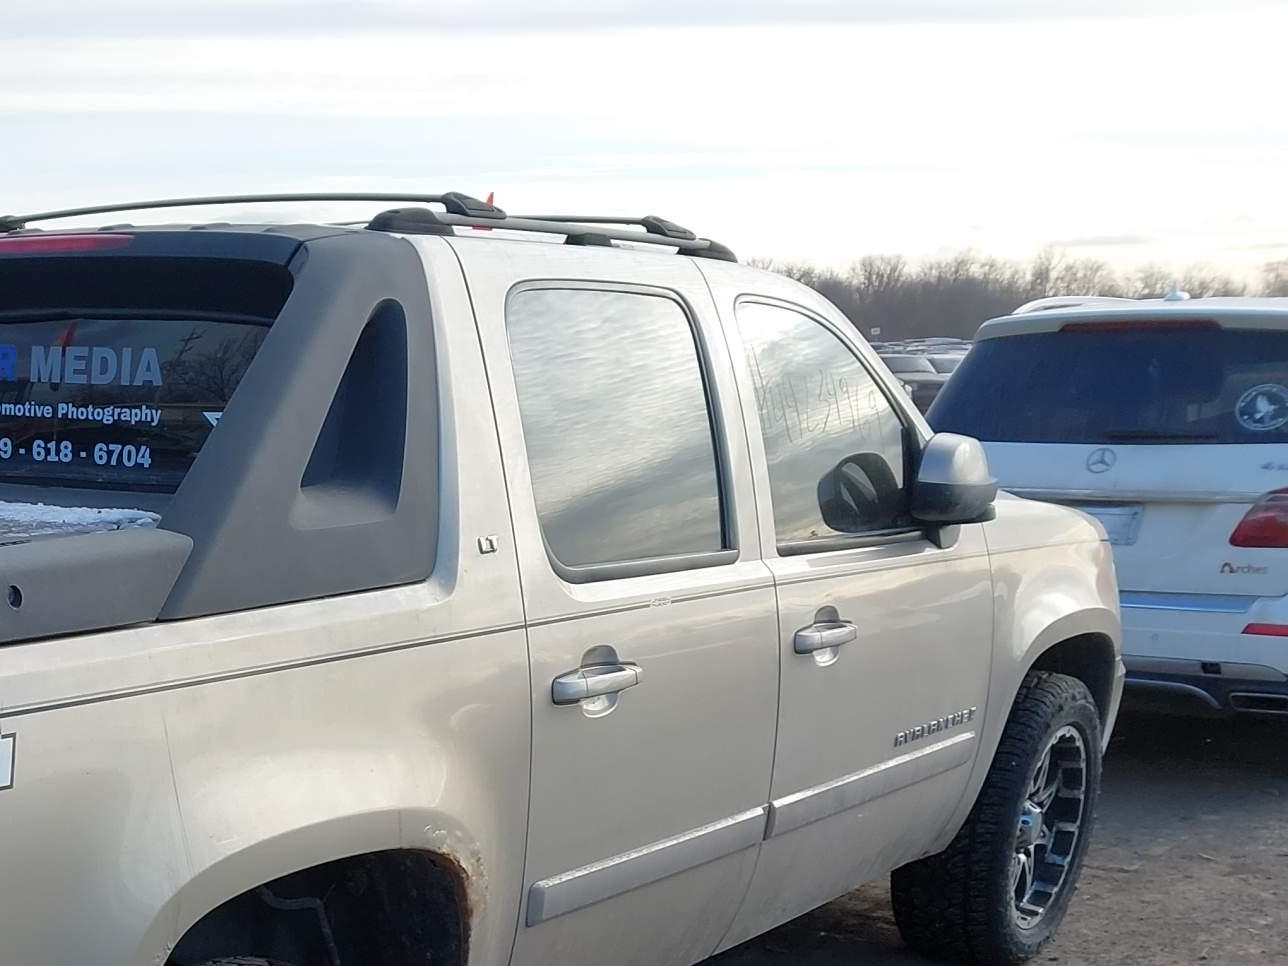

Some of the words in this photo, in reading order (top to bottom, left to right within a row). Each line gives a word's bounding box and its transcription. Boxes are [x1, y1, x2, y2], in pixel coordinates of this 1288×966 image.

[30, 345, 163, 386] MEDIA
[57, 403, 162, 426] Photography
[32, 440, 73, 462] 618
[94, 443, 152, 468] 6704
